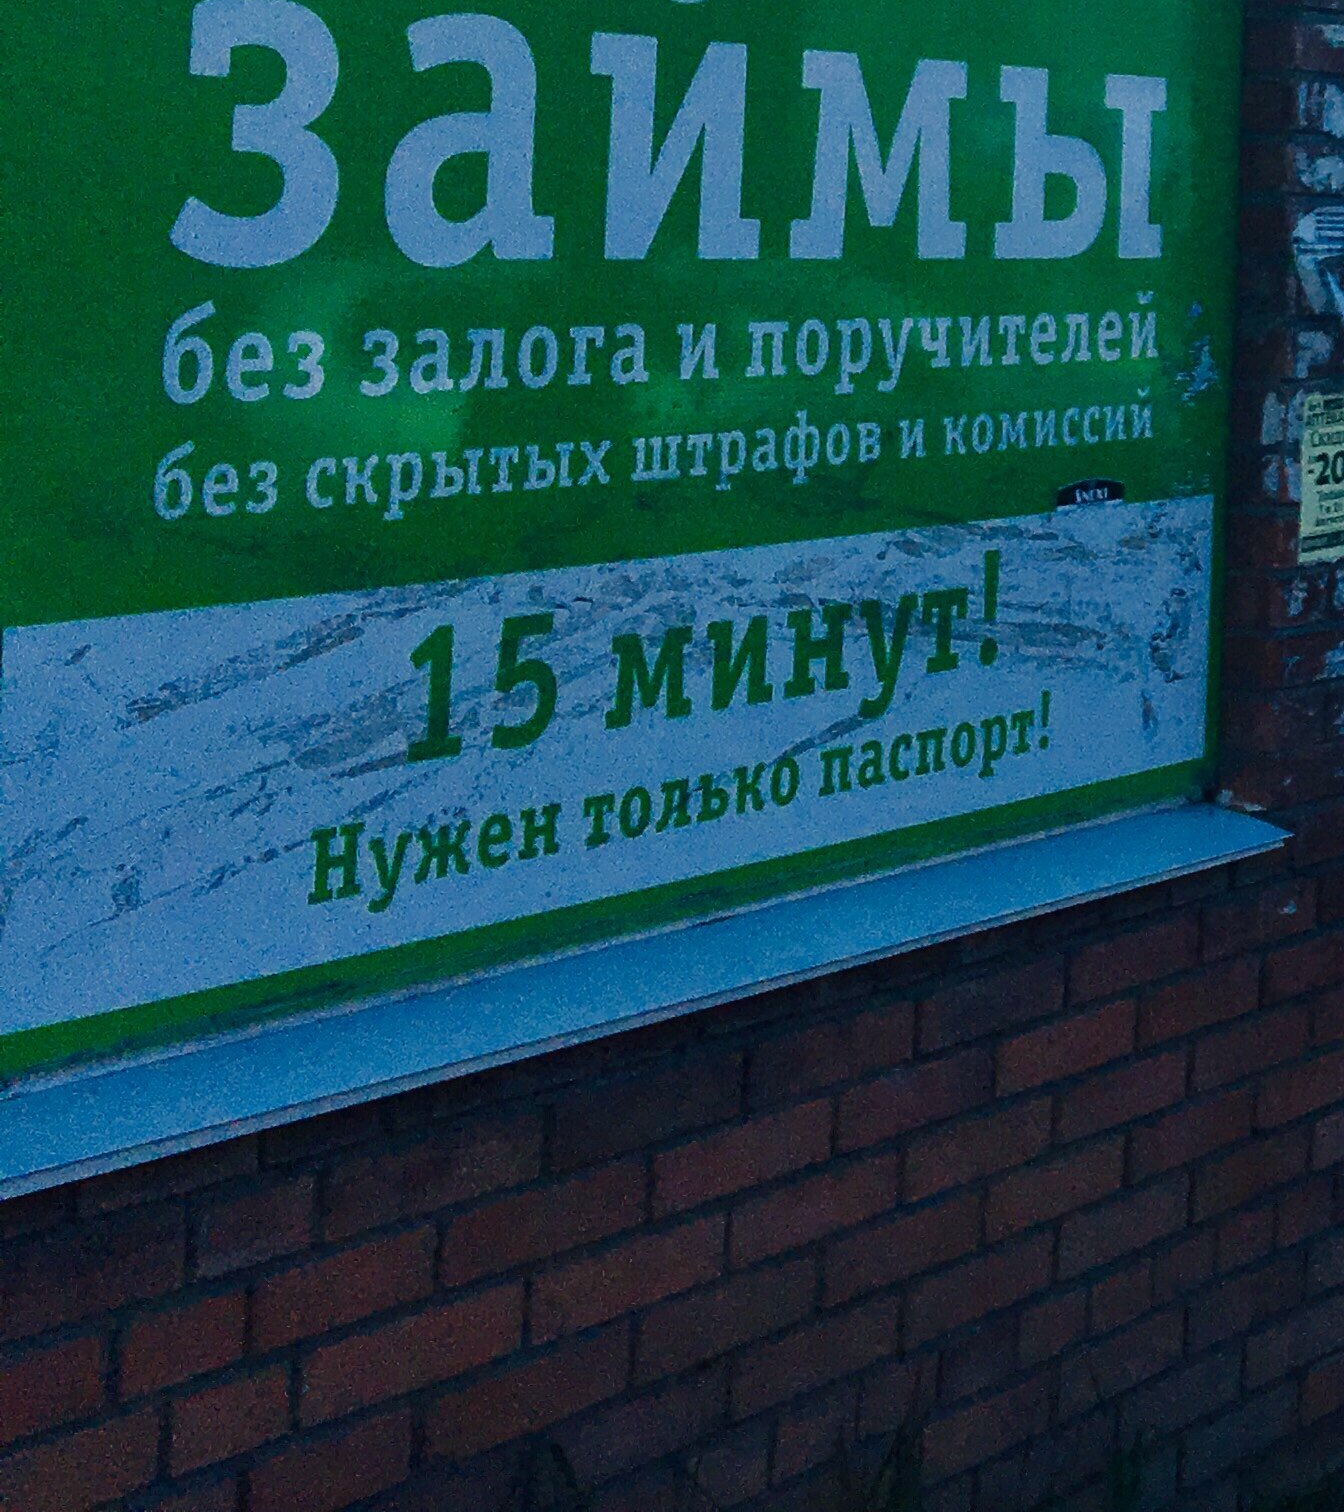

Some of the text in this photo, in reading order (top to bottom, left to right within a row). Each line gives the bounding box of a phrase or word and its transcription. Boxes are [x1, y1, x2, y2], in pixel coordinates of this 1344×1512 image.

[160, 291, 1160, 404] без залога и поручителей
[152, 393, 1156, 522] без скрытых штрафов и комиссий
[407, 548, 1003, 764] 15 минут!
[305, 689, 1053, 916] Нужен только паспорт!
